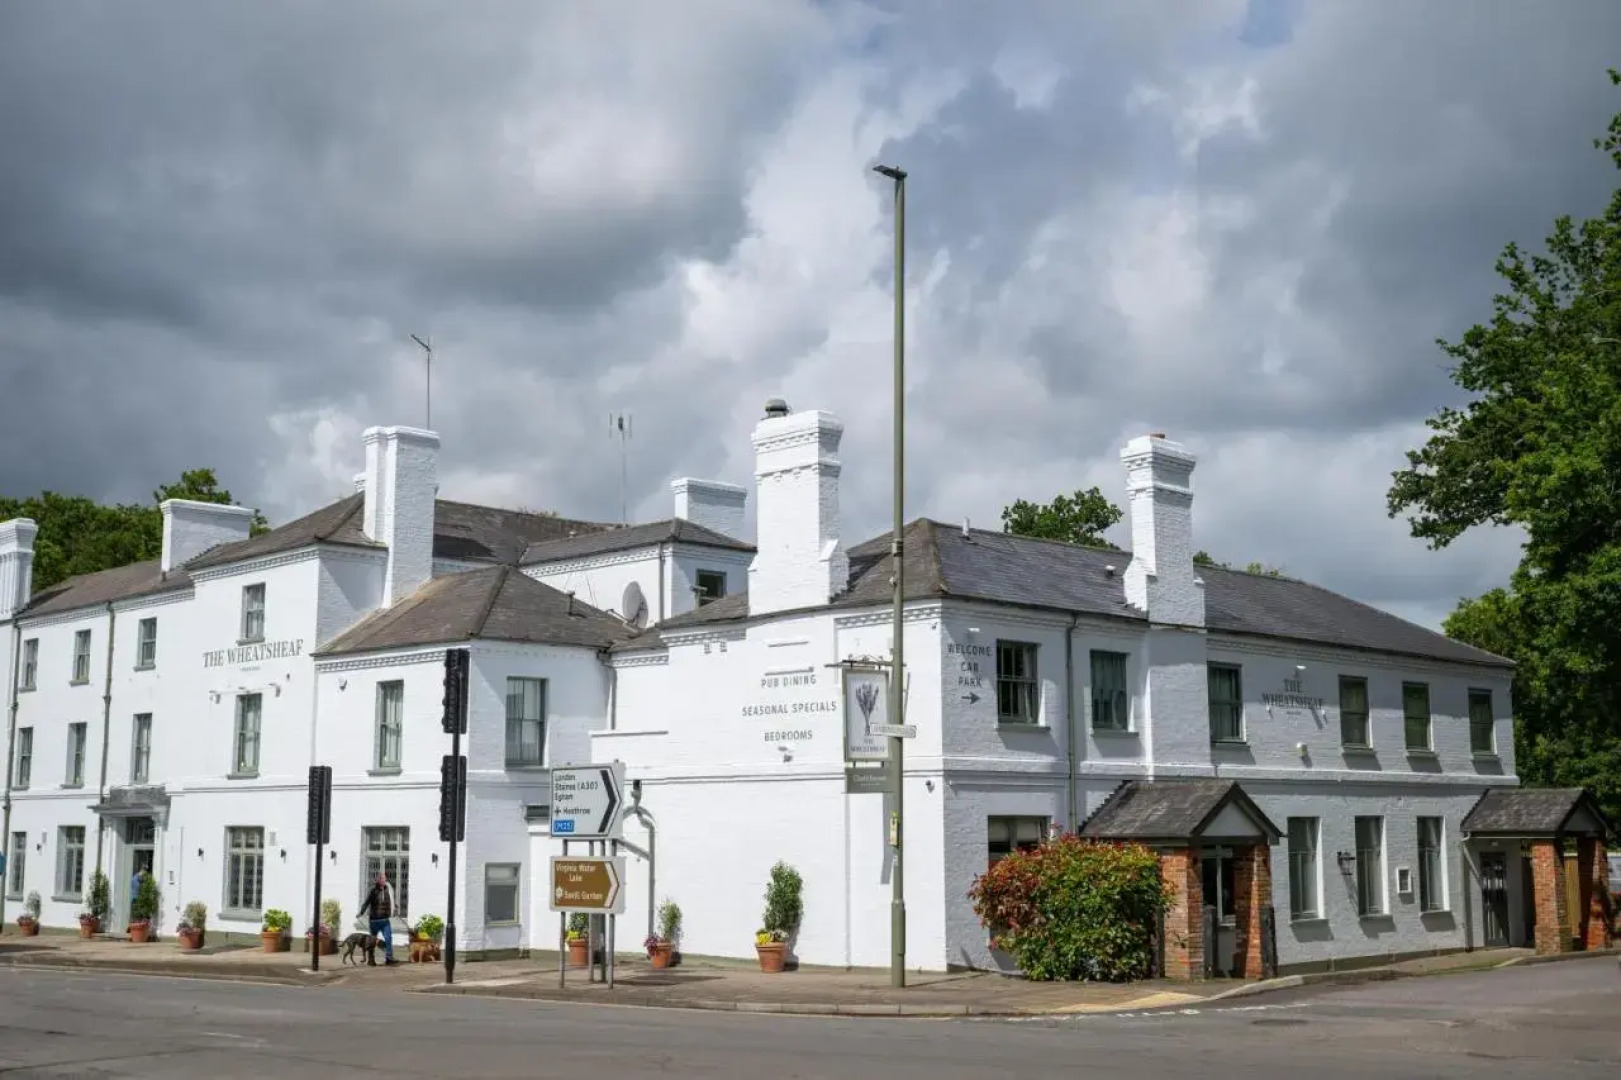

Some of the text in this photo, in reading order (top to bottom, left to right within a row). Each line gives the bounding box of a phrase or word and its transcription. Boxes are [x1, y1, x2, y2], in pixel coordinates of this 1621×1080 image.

[203, 638, 304, 668] THE WHEATSHEAF
[947, 643, 993, 657] WELCOME
[960, 661, 979, 673] CAR
[761, 674, 816, 688] PUB DINING
[958, 676, 982, 688] PARK
[1283, 678, 1302, 694] THE
[742, 701, 837, 717] SEASONAL SPECIALS
[764, 730, 813, 742] BEDROOMS
[577, 781, 598, 790] (A30)
